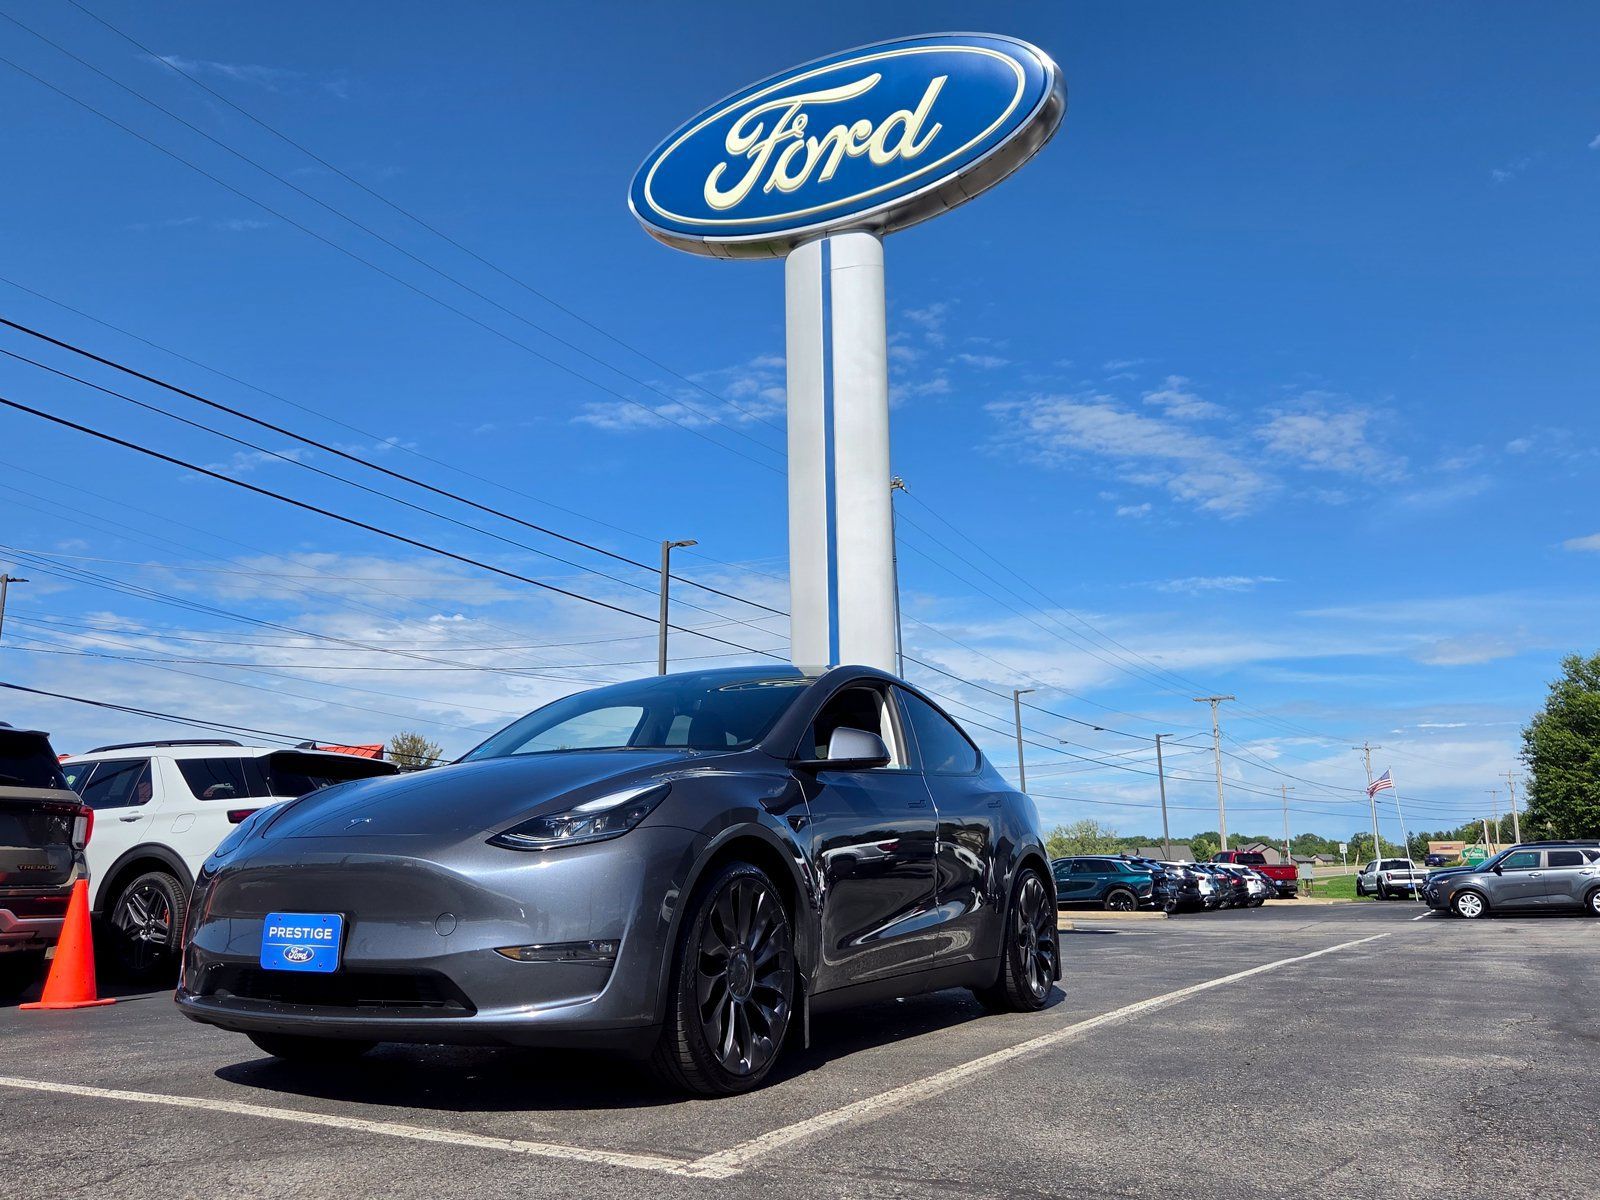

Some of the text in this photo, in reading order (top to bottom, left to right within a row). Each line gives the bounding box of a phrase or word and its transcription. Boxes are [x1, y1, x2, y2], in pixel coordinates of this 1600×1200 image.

[704, 72, 948, 211] Ford
[268, 926, 333, 940] PRESTIGE
[288, 946, 309, 960] Ford
